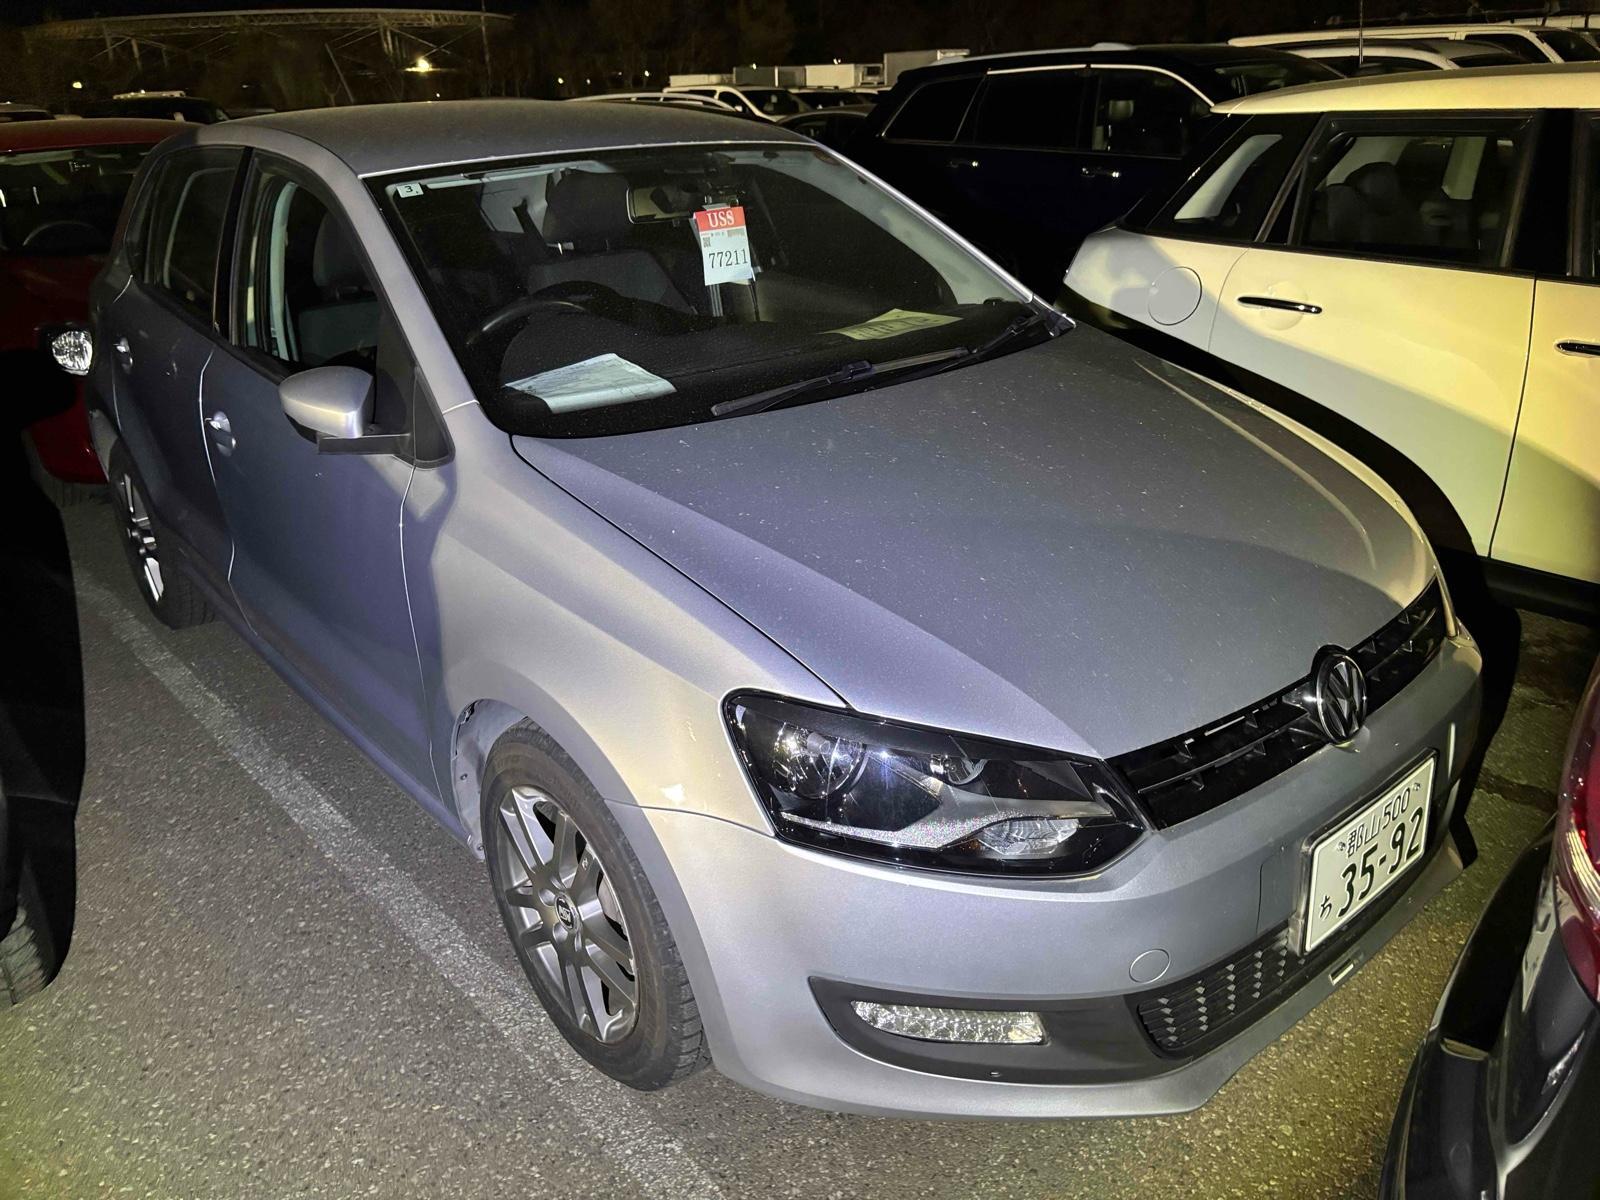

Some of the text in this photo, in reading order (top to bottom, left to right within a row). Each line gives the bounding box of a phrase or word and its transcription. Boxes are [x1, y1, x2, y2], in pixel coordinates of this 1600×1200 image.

[707, 210, 735, 228] USS
[708, 248, 749, 269] 77211
[1338, 806, 1424, 918] 35-92
